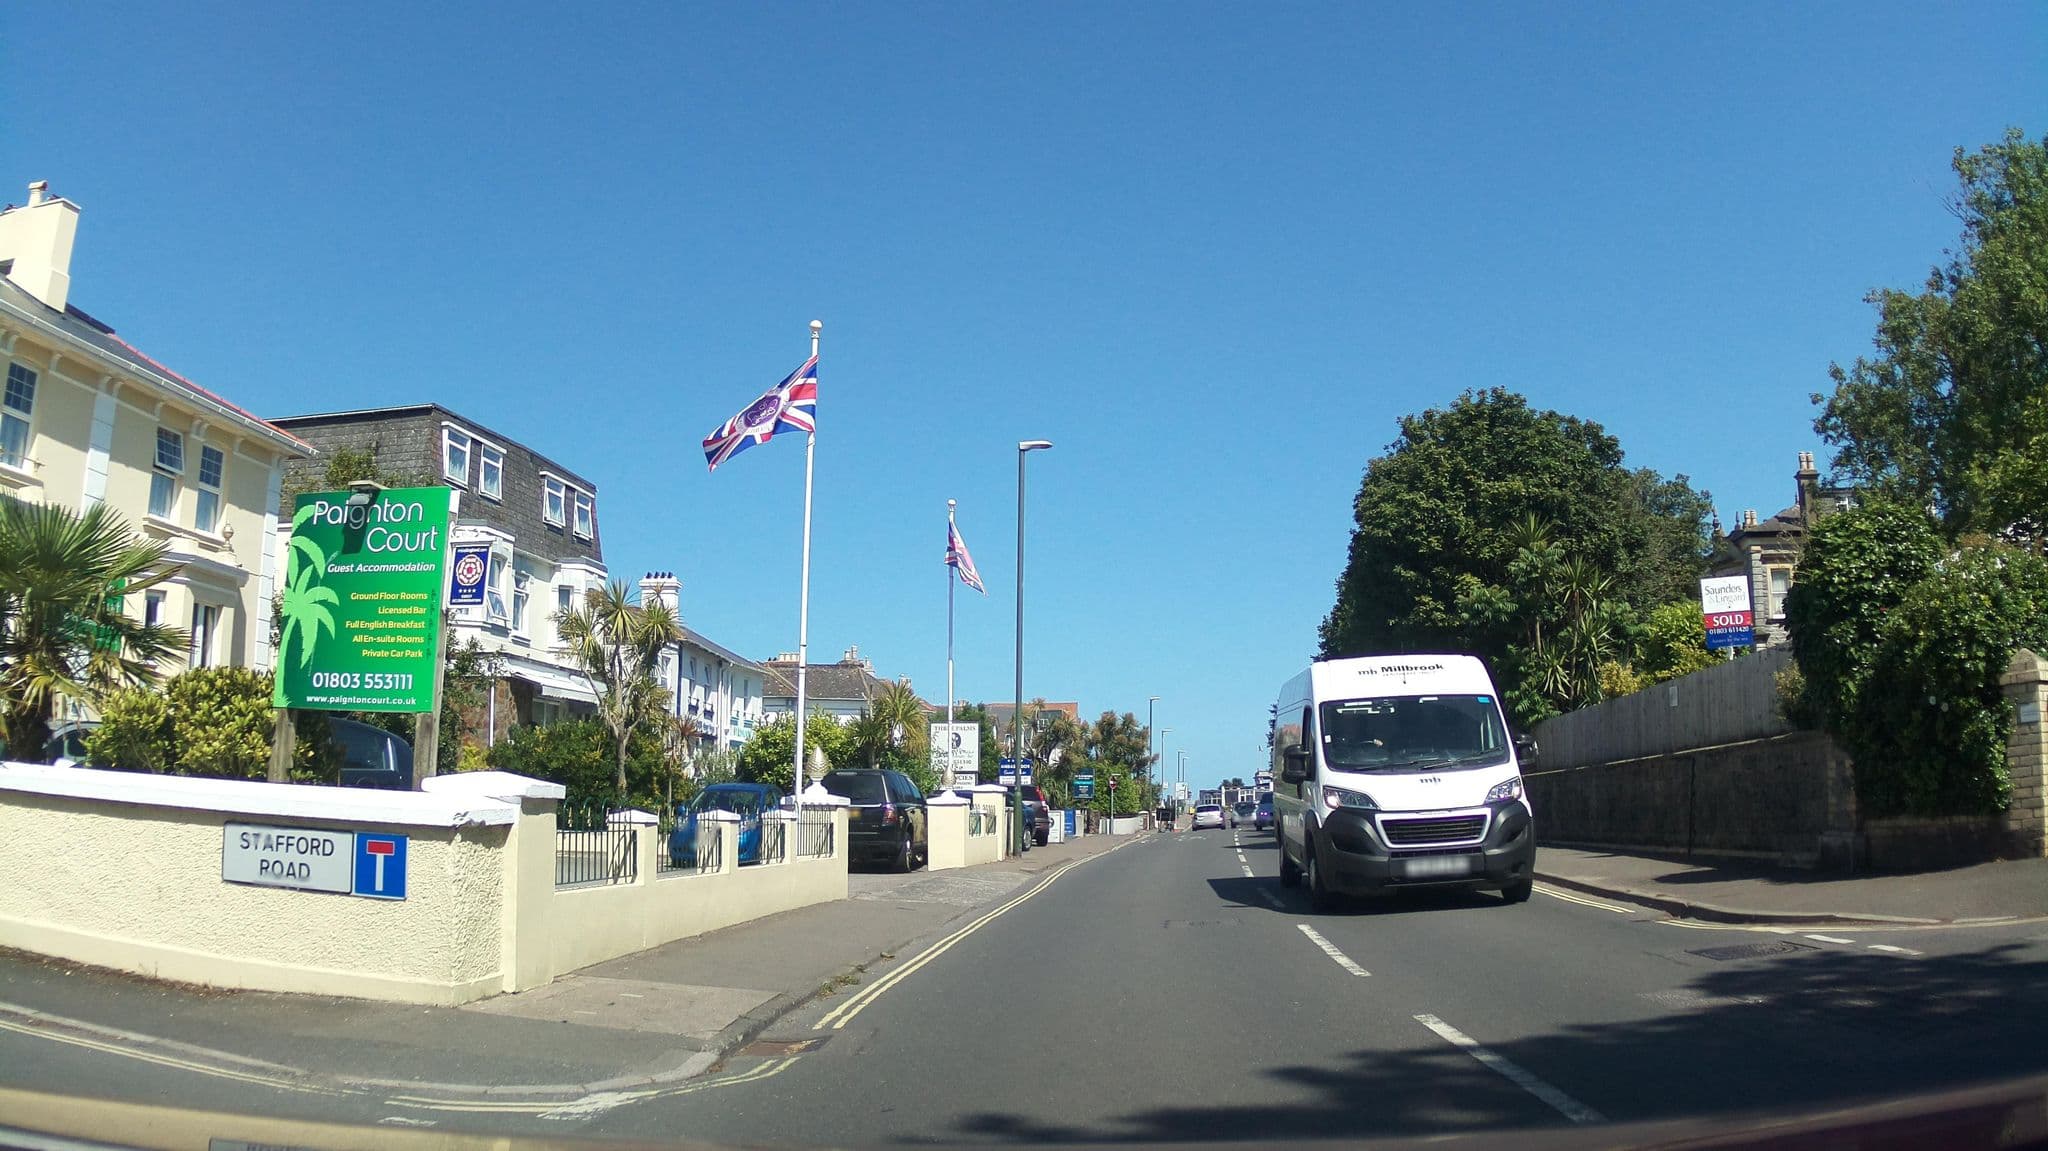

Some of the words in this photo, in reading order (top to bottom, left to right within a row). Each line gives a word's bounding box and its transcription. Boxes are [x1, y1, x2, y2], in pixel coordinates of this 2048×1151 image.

[313, 498, 423, 529] Paignton
[366, 526, 438, 552] Court
[327, 563, 354, 573] Guest
[355, 561, 436, 573] Accommodation
[1704, 584, 1742, 595] Saunders
[350, 592, 379, 600] Ground
[379, 592, 400, 600] Floor
[400, 592, 428, 600] Rooms
[378, 606, 413, 614] Licensed
[413, 606, 427, 614] Bar
[345, 621, 360, 629] Full
[360, 621, 388, 630] English
[388, 621, 425, 629] Breakfast
[1712, 614, 1744, 627] SOLD
[352, 635, 363, 643] All
[363, 635, 396, 643] En-suite
[396, 635, 425, 643] Rooms
[362, 649, 390, 657] Private
[390, 649, 404, 657] Car
[404, 649, 423, 657] Park
[1381, 663, 1444, 673] Millbrook
[312, 672, 360, 688] 01803
[364, 673, 413, 690] 553111
[306, 695, 417, 705] www.paigntoncourt.co.uk
[240, 831, 335, 857] STAFFORD
[259, 858, 311, 880] ROAD
